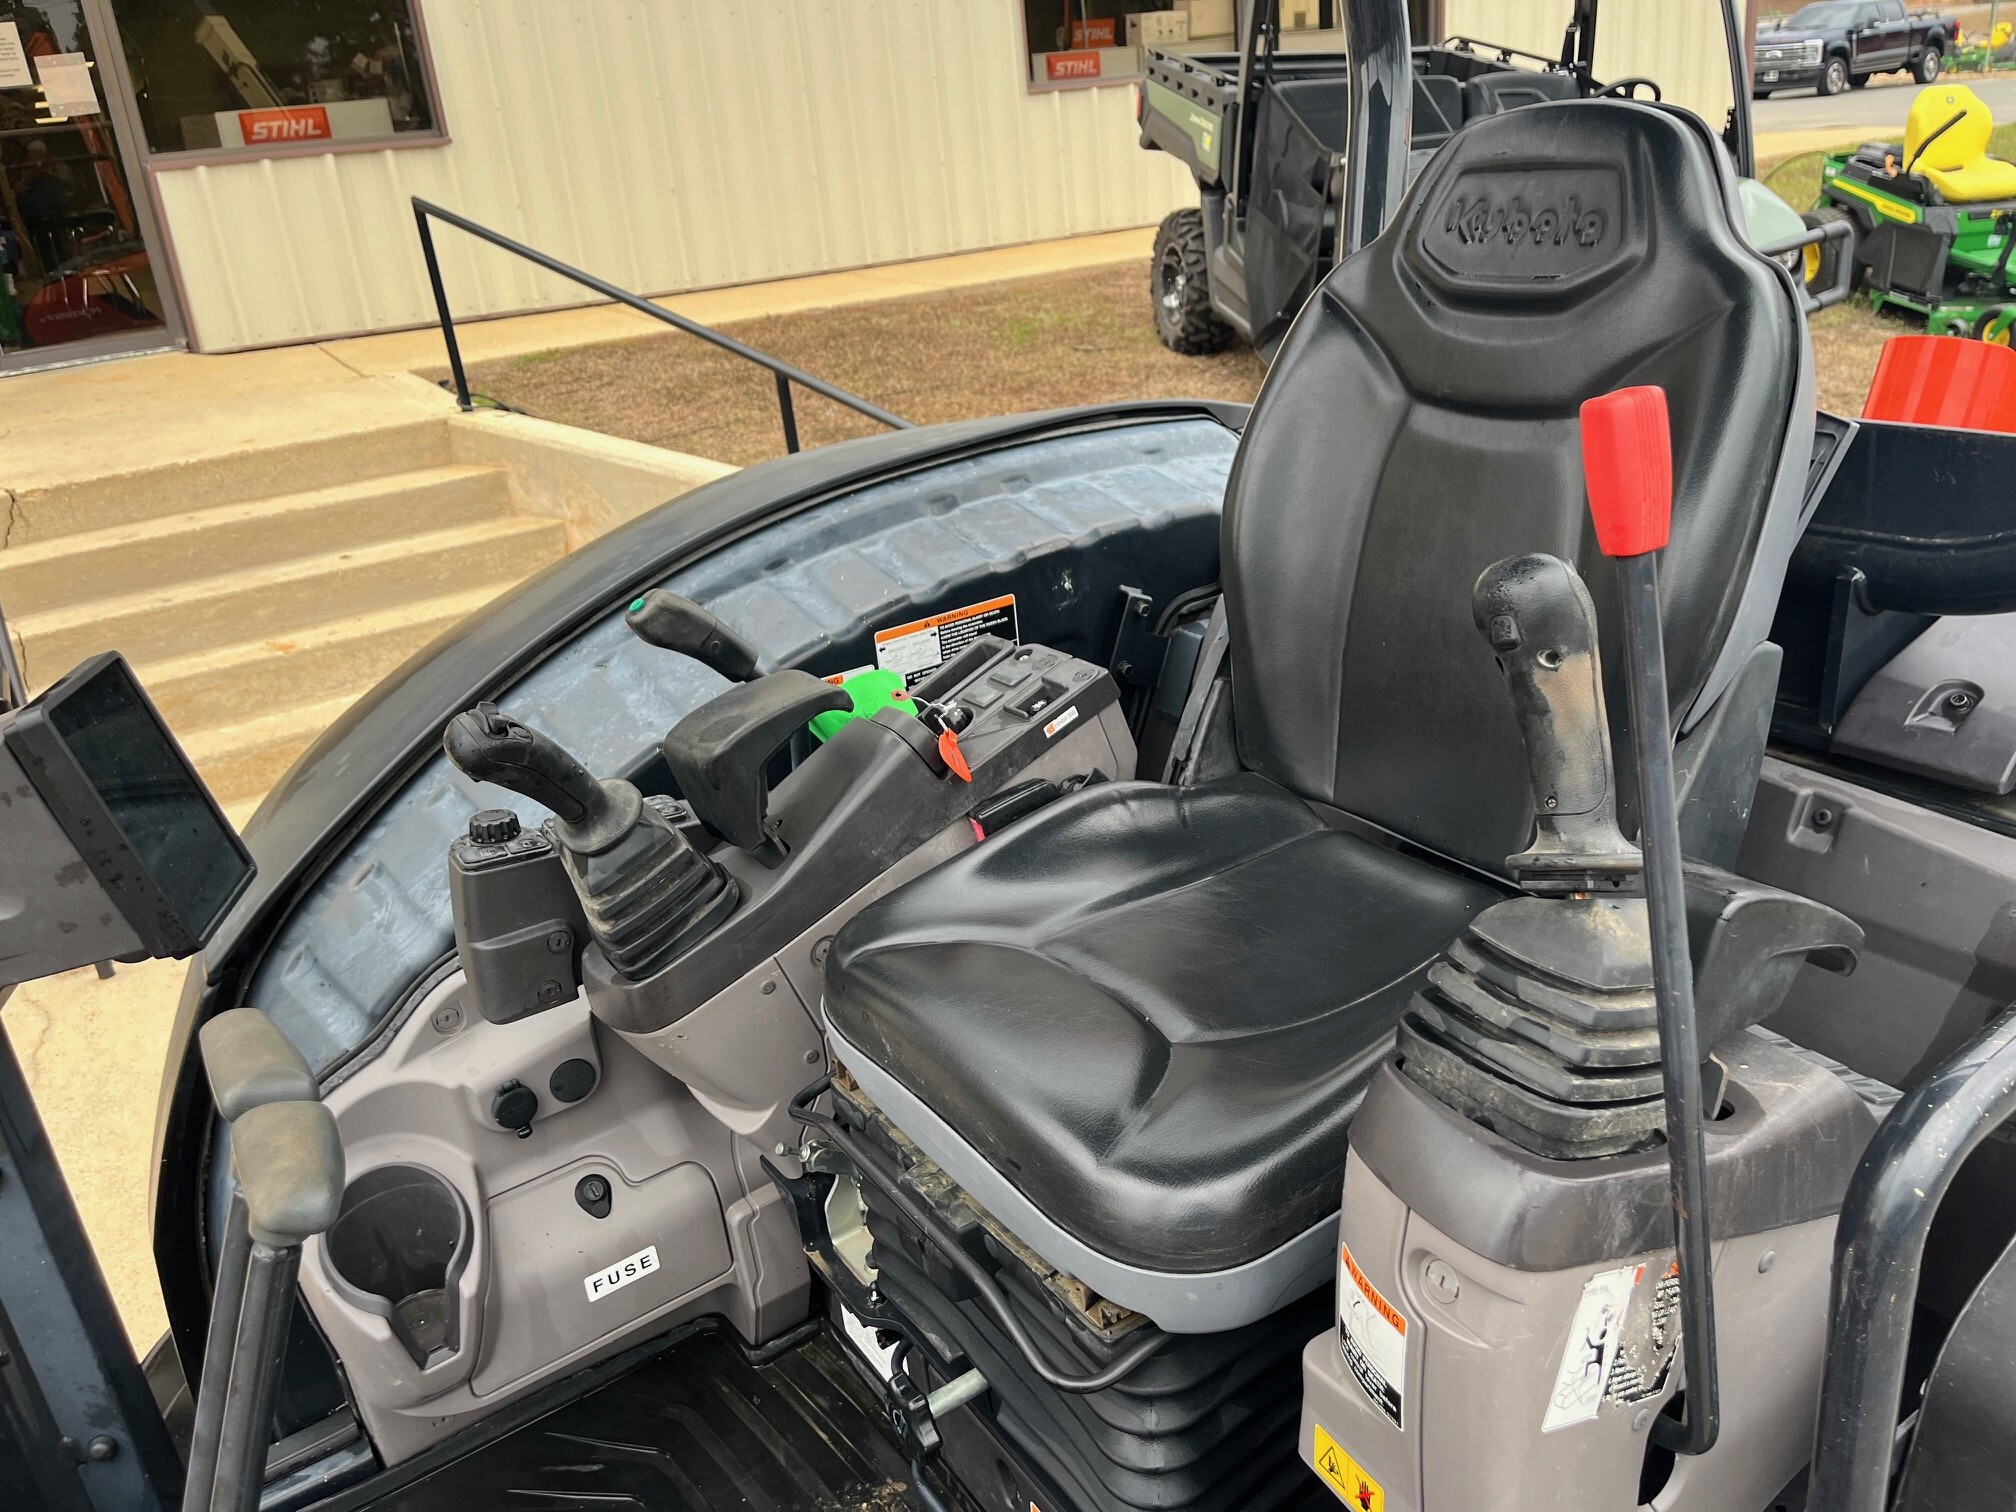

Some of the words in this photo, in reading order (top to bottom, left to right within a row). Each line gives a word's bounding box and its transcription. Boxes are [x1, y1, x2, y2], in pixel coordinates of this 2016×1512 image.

[1073, 26, 1112, 41] STIHL
[1054, 59, 1099, 76] STIHL
[251, 118, 322, 140] STIHL
[1445, 193, 1607, 248] Kubota
[936, 610, 969, 624] WARNING
[593, 1254, 653, 1293] FUSE
[1349, 1265, 1400, 1329] WARNING
